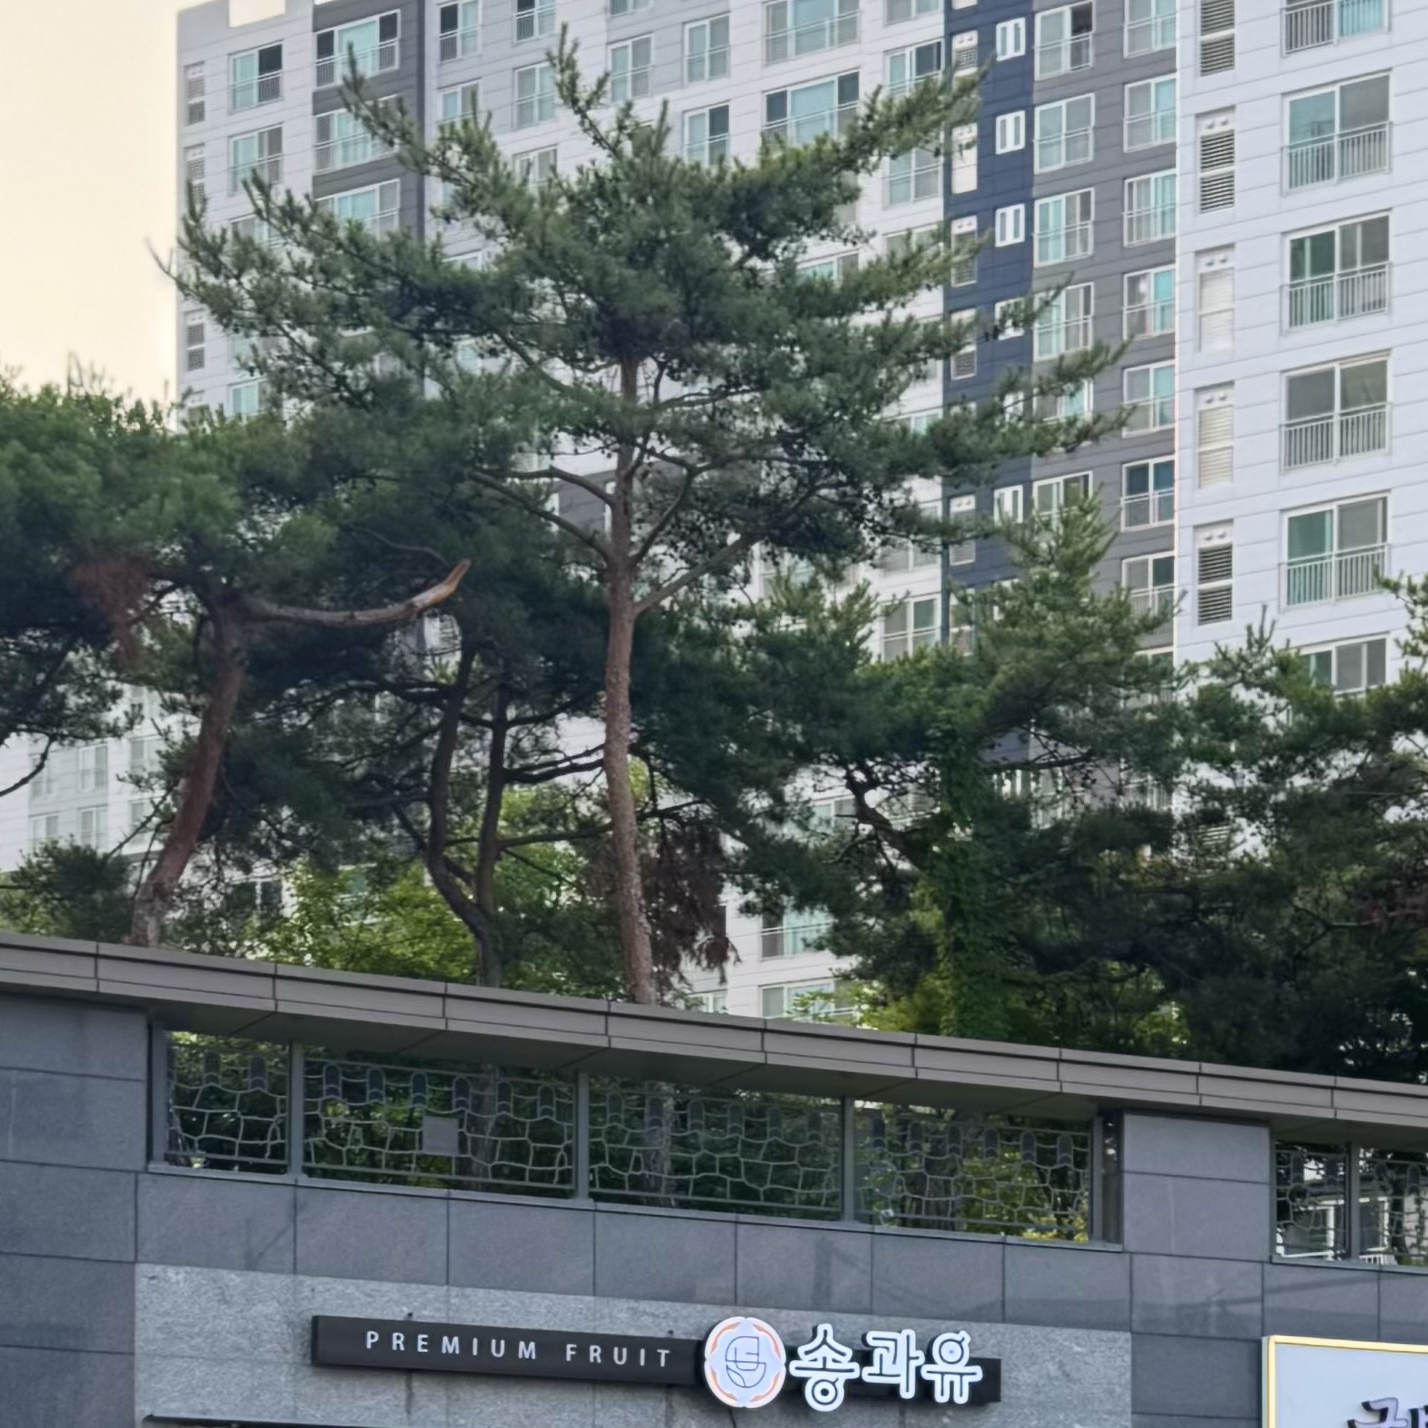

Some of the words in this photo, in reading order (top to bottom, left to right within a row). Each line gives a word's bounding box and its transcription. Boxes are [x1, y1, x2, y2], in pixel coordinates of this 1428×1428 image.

[366, 1330, 536, 1361] PREMIUM
[565, 1343, 670, 1369] FRUIT
[790, 1322, 983, 1412] 송과유
